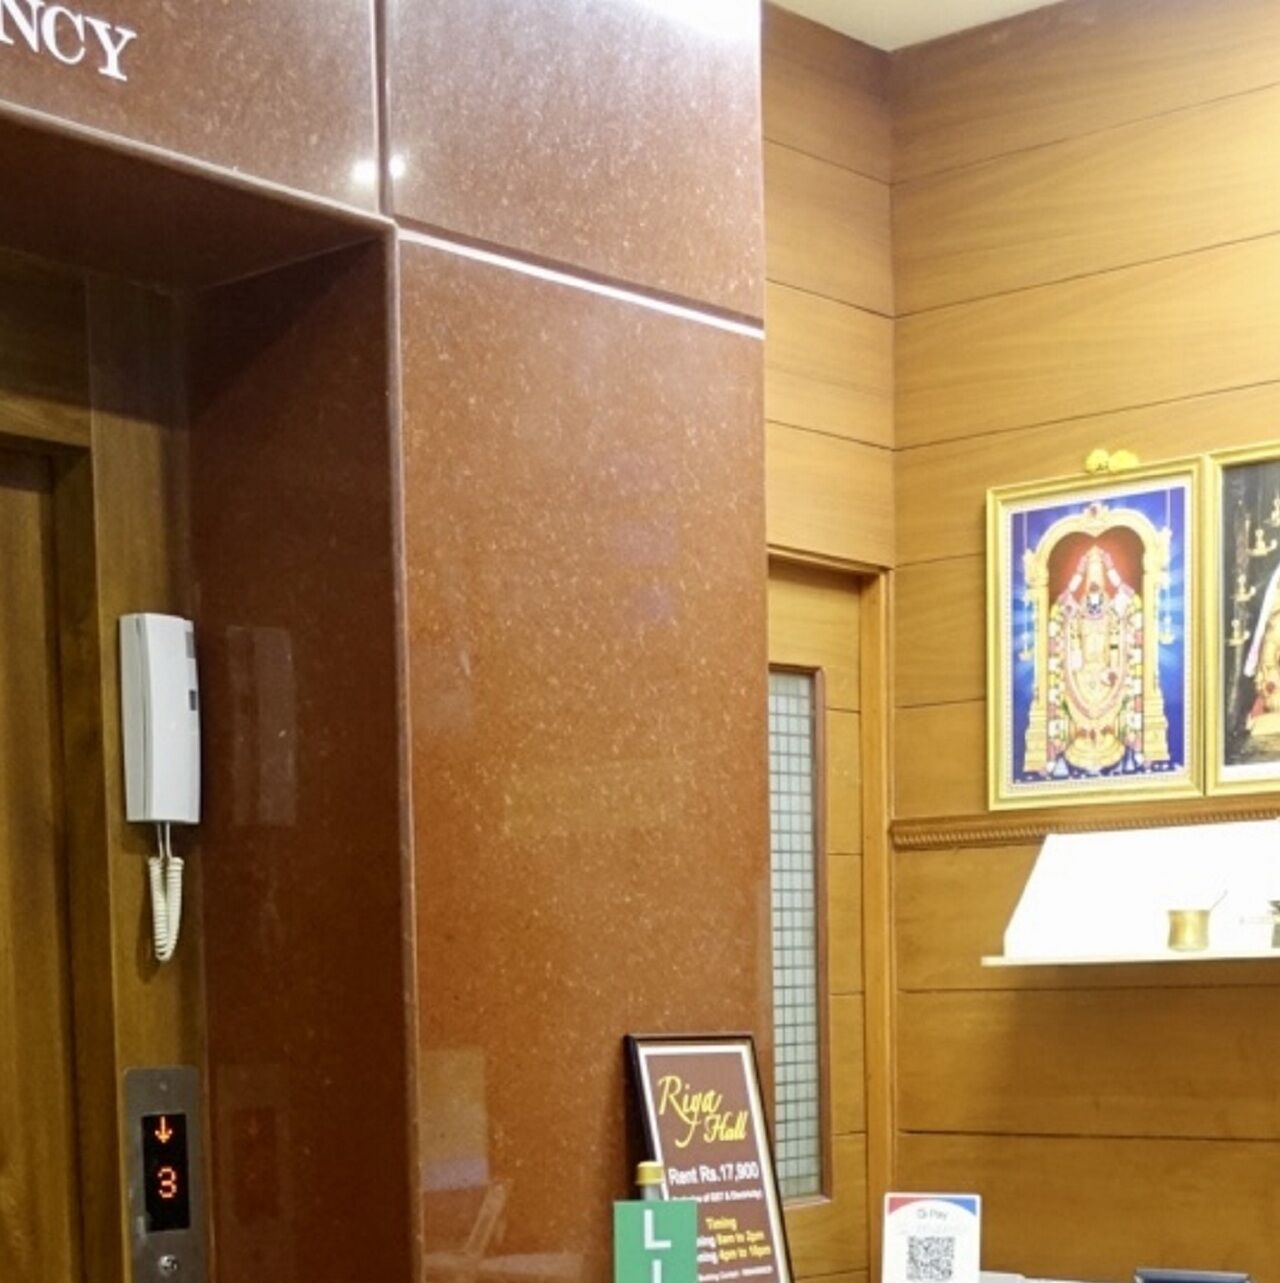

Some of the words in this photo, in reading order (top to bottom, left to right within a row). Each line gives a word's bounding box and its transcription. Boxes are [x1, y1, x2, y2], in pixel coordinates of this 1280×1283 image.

[657, 1075, 723, 1148] Riya
[703, 1111, 749, 1143] Hall
[157, 1166, 177, 1198] 3
[668, 1167, 698, 1186] Rent
[705, 1216, 737, 1231] Timing
